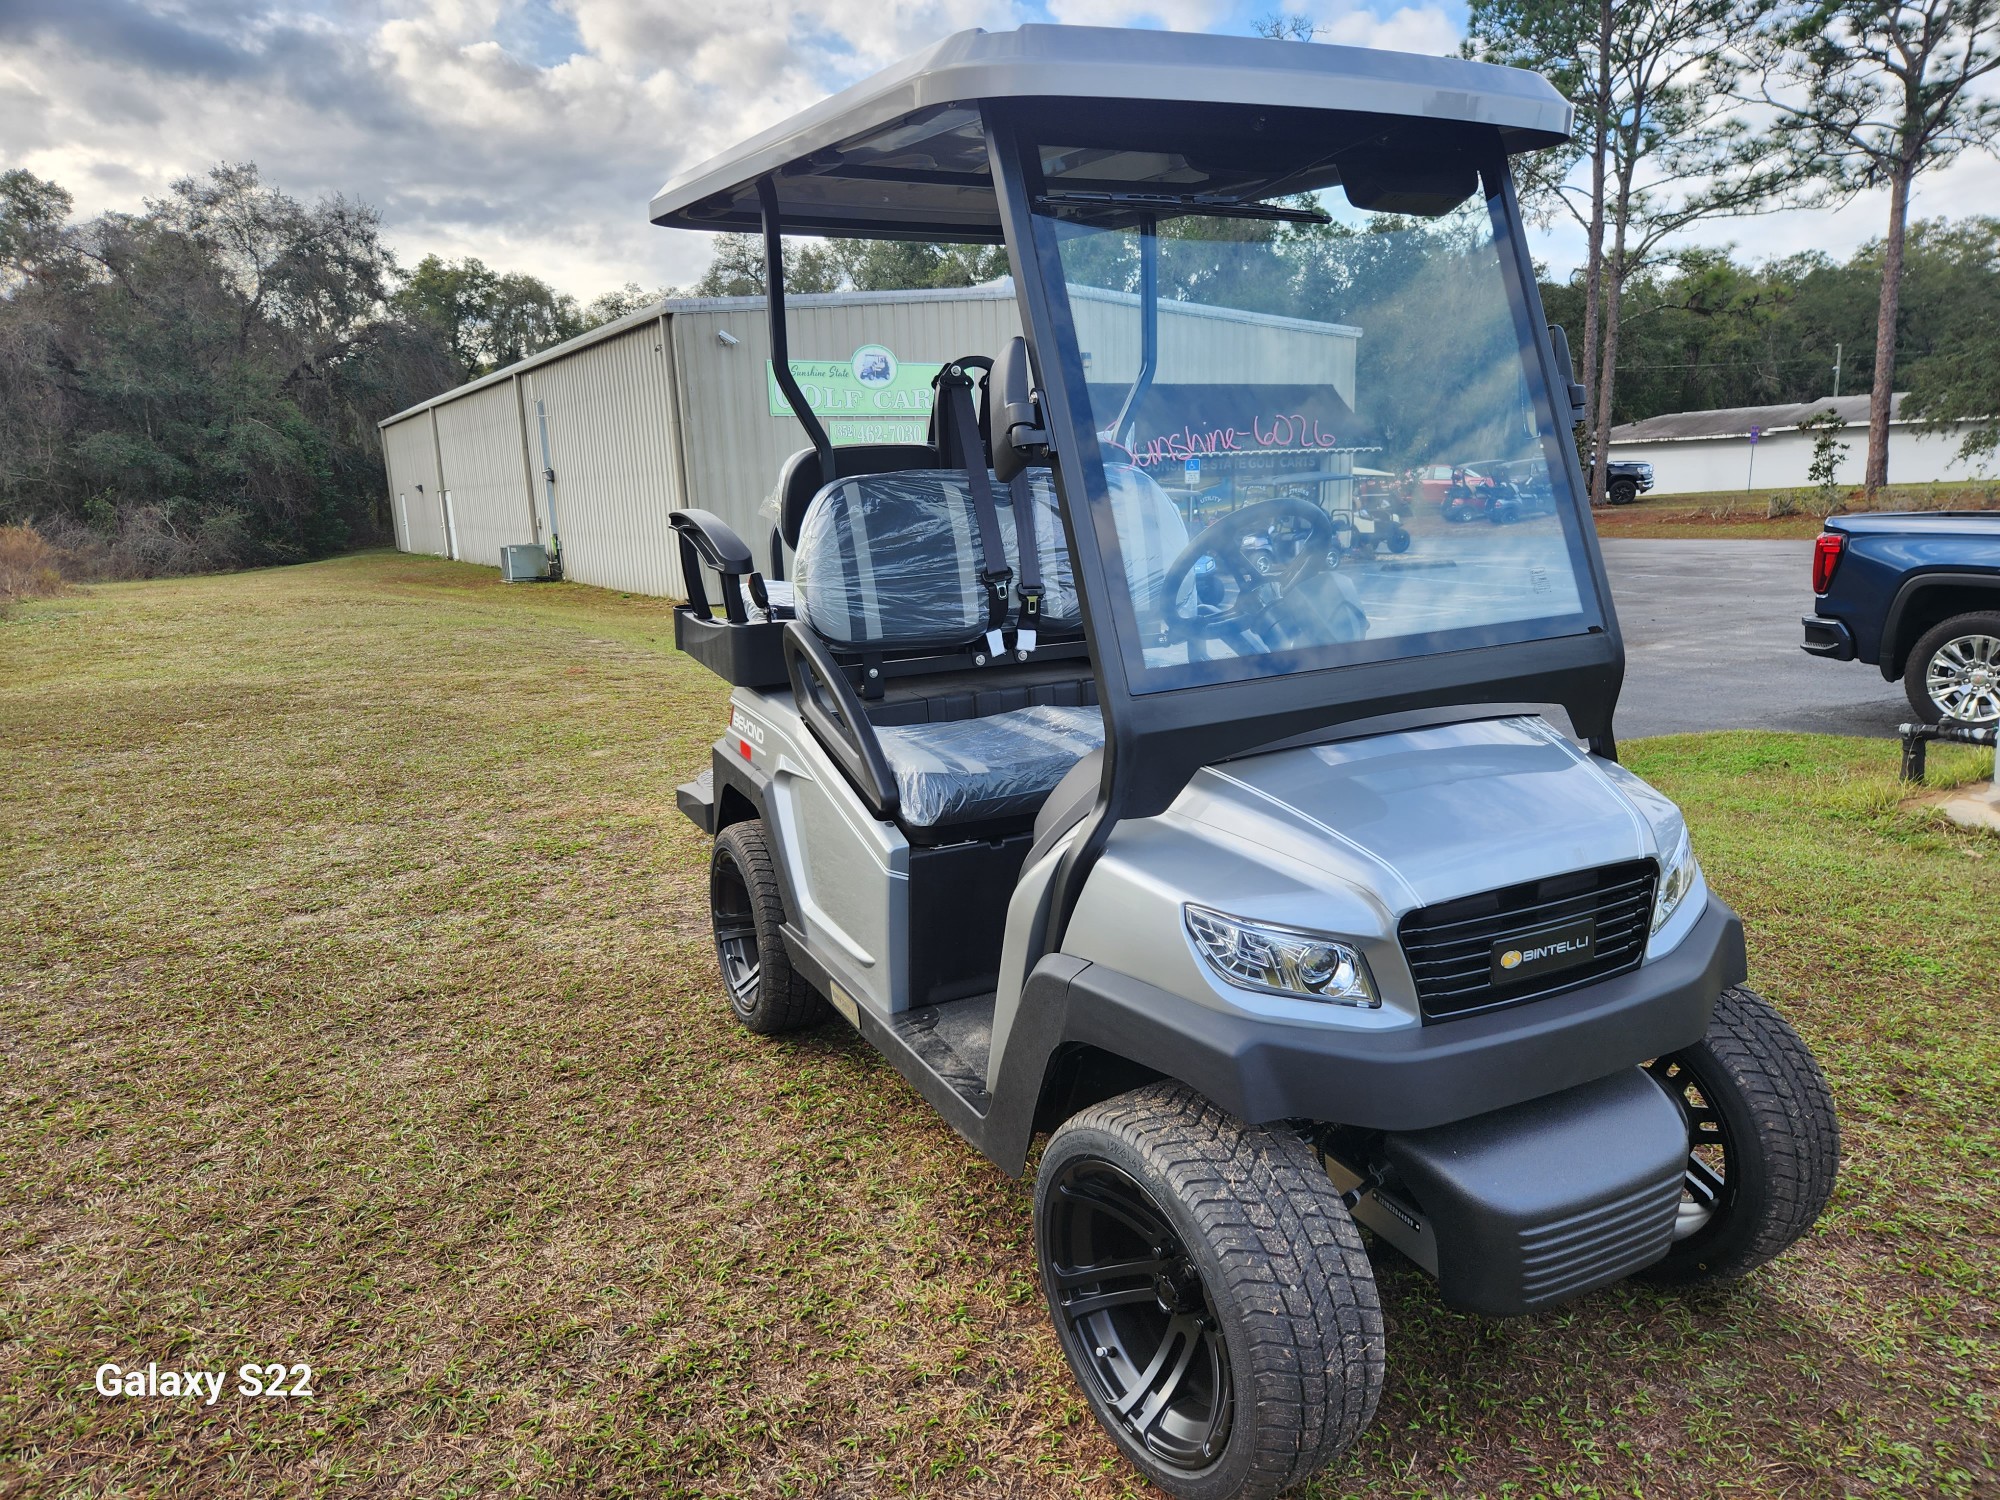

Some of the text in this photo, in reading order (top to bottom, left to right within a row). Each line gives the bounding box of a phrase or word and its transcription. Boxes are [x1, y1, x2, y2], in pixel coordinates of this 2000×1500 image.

[790, 364, 850, 378] Sunshine State
[858, 424, 921, 444] 462-7030
[1280, 455, 1316, 468] CARTS
[1200, 495, 1222, 504] UTILITY
[733, 711, 764, 744] BEYOND
[1523, 936, 1589, 962] BINTELLI
